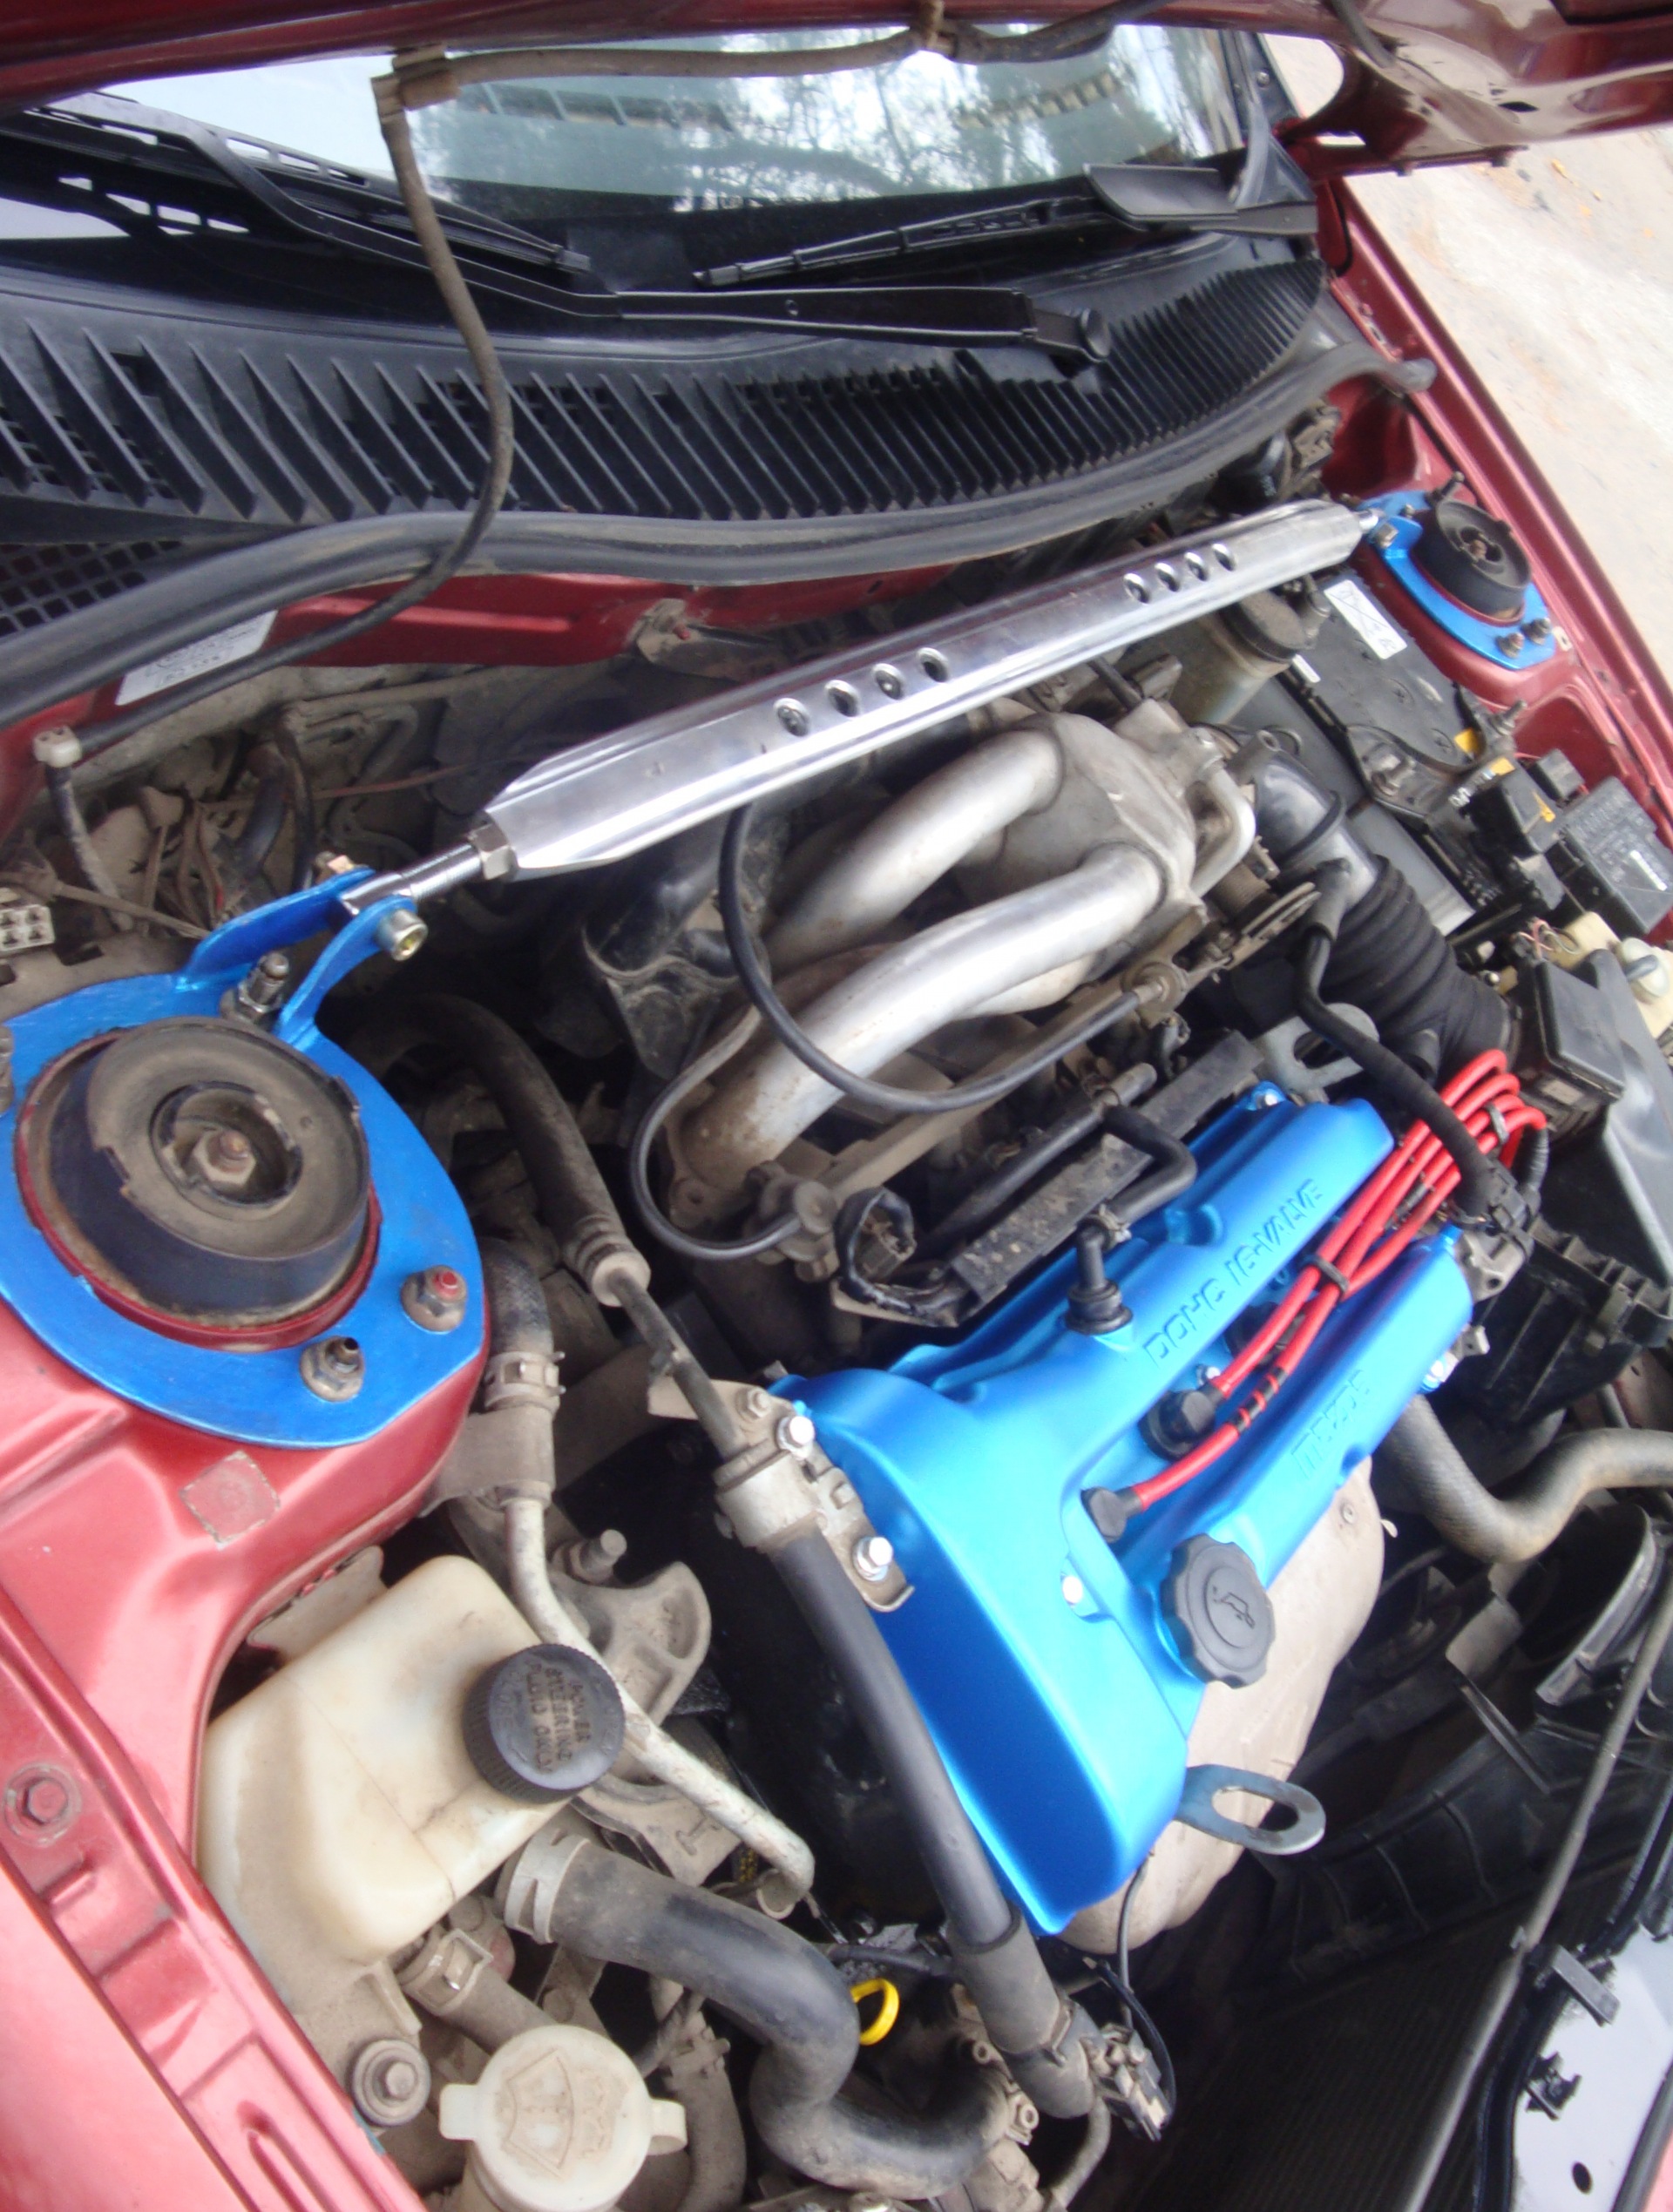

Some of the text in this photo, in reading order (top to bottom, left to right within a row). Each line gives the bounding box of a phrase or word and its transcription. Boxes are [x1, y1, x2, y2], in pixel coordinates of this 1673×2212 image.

[1142, 1177, 1324, 1367] DOHC 16-VALVE
[567, 1679, 593, 1742] POWER
[533, 1726, 554, 1773] ONLY
